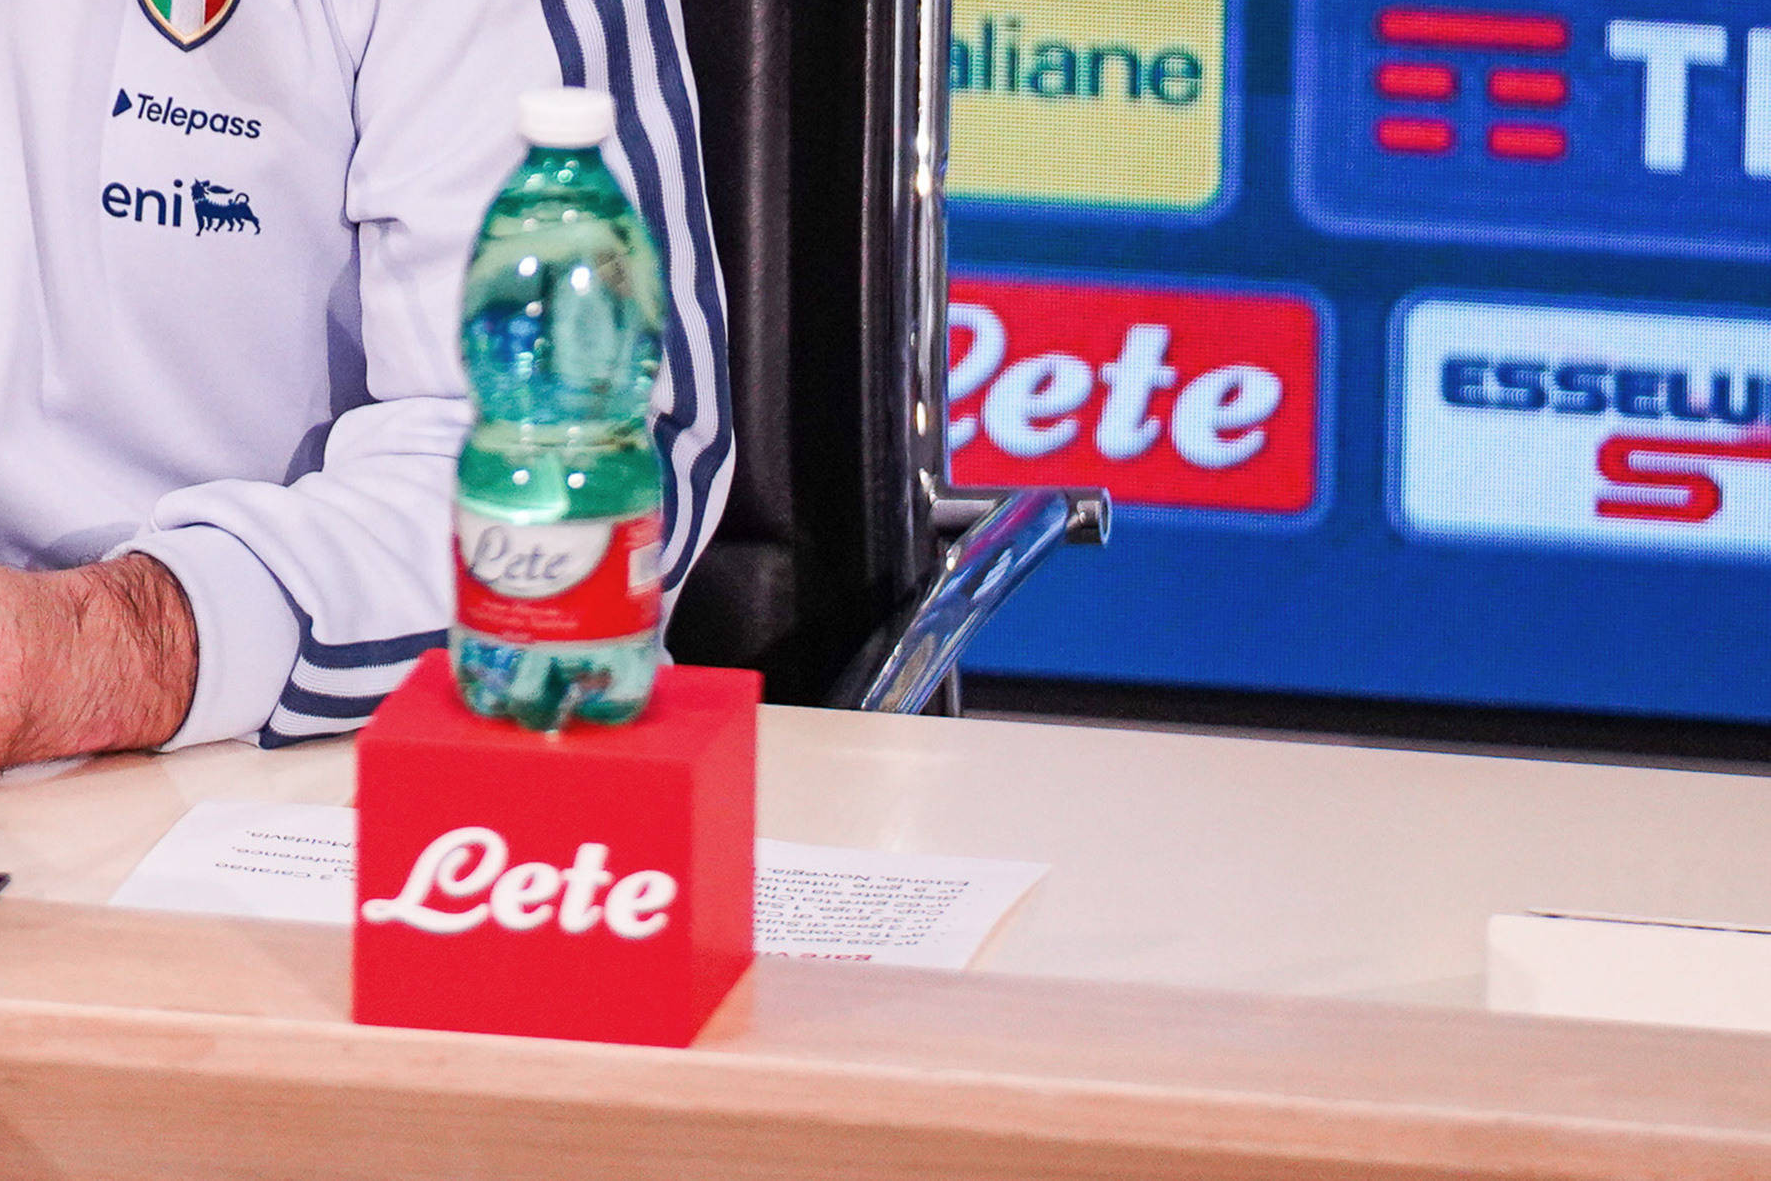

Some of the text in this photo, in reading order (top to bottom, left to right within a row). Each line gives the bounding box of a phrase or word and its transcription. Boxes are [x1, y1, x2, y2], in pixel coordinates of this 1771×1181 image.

[137, 93, 262, 139] Telepass
[101, 180, 183, 228] eni
[1441, 359, 1771, 426] ESSELU
[468, 525, 571, 586] Lete
[361, 826, 679, 940] Lete
